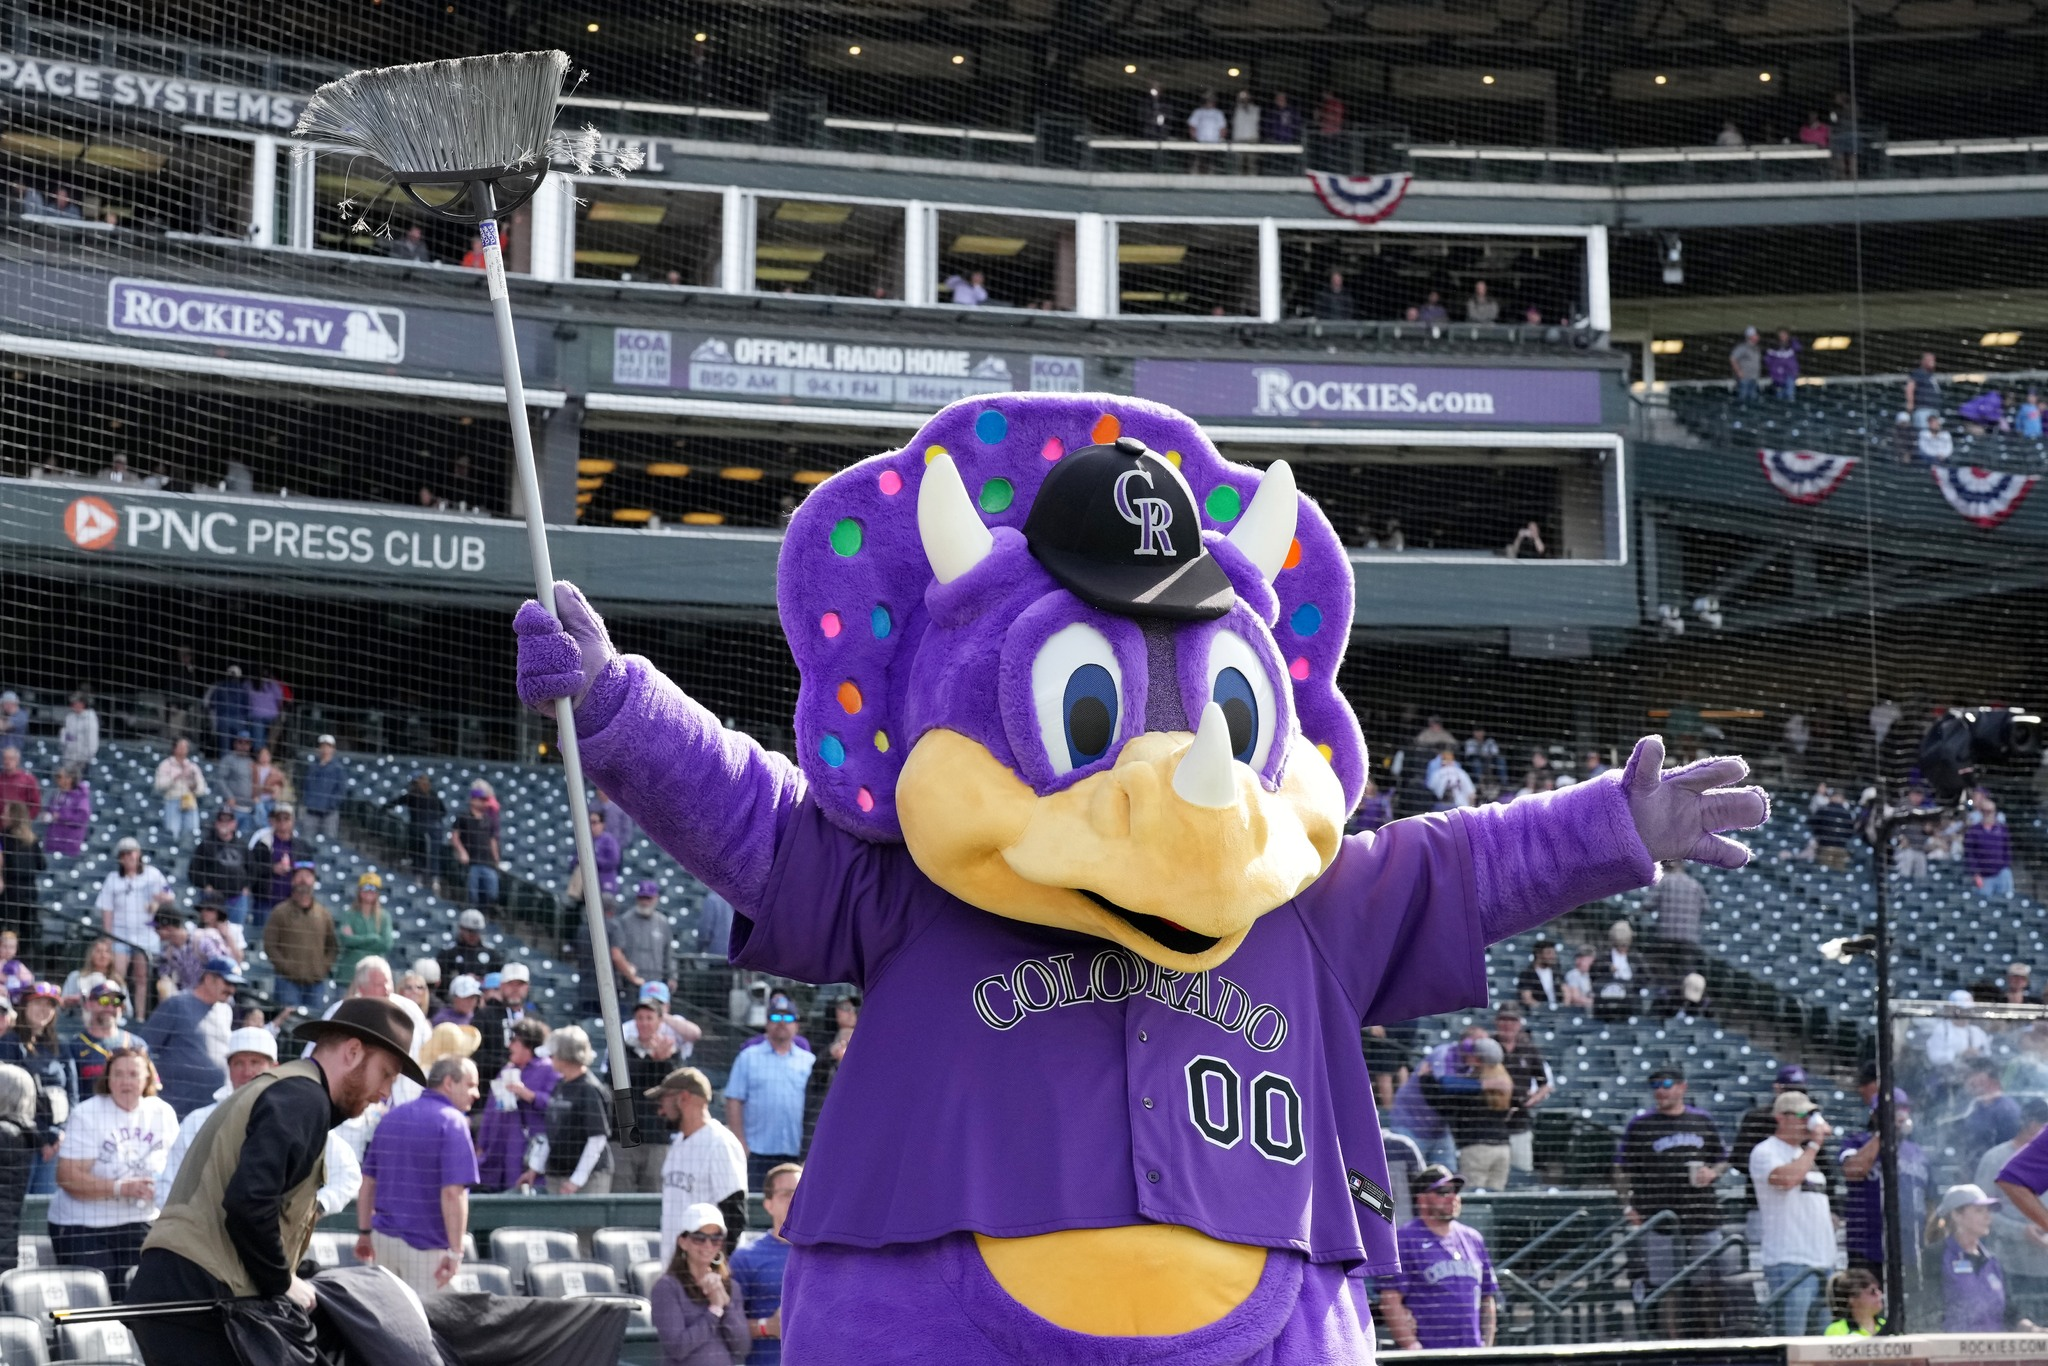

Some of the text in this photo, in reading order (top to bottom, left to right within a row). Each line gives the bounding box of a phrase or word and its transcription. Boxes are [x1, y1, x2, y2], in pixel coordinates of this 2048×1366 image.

[0, 56, 295, 128] PACE SYSTEMS
[619, 334, 666, 351] KOA
[734, 337, 970, 377] OFFICIAL RADIO HOME
[1034, 360, 1079, 378] KOA
[701, 370, 779, 390] 850 AM
[851, 379, 879, 396] FM
[124, 505, 486, 572] PNC PRESS CLUB
[972, 949, 1288, 1053] COLORADO
[1183, 1054, 1306, 1165] 00
[1828, 1342, 1913, 1358] ROCKIES.COM
[1959, 1340, 2047, 1354] ROCKIES.COM
